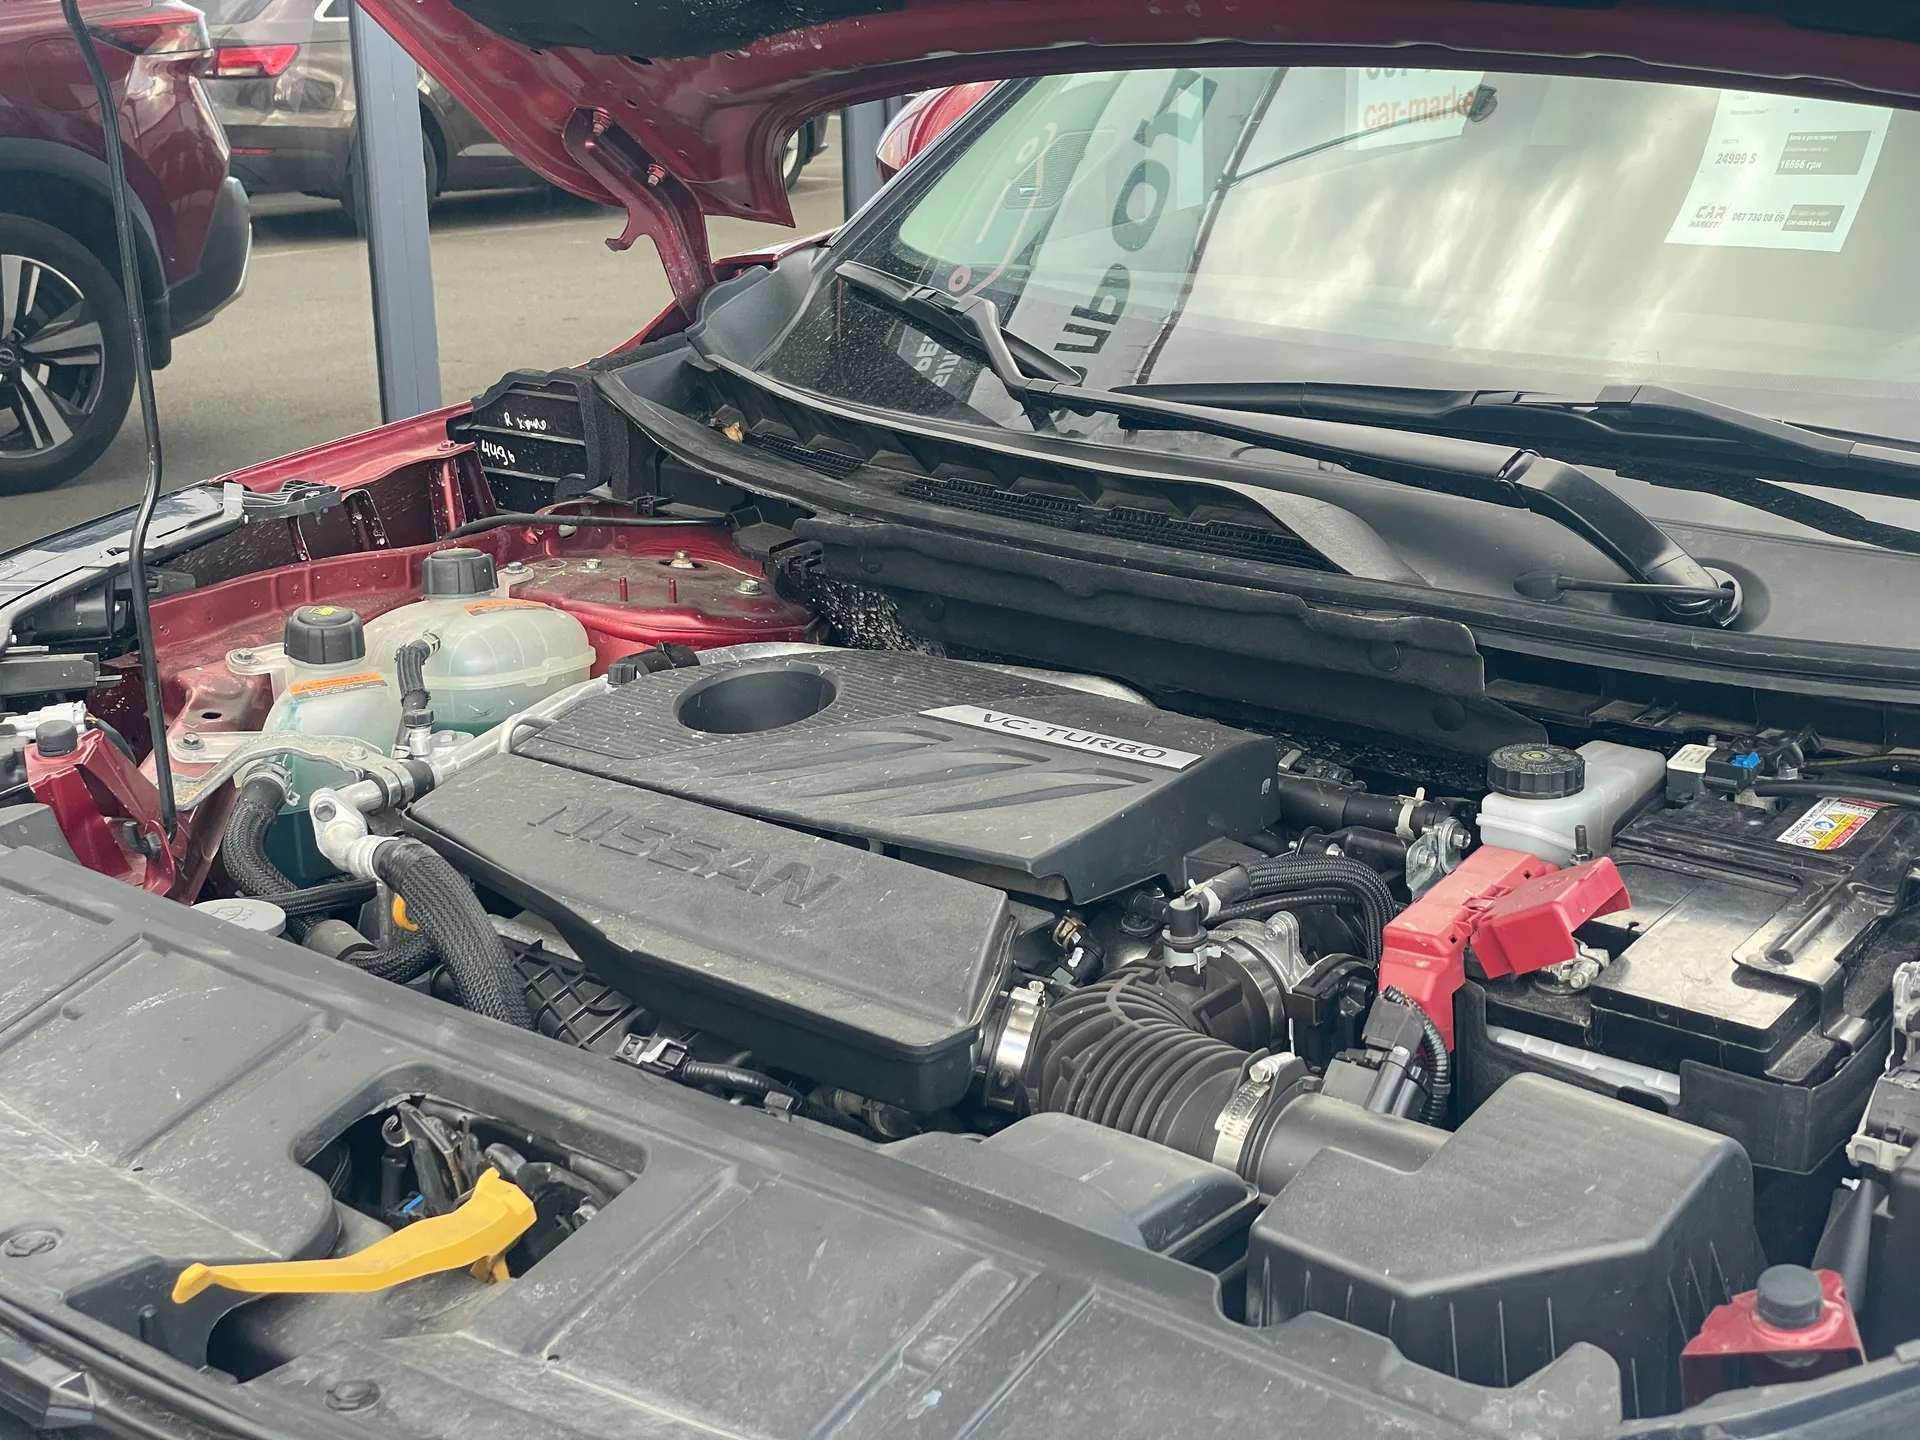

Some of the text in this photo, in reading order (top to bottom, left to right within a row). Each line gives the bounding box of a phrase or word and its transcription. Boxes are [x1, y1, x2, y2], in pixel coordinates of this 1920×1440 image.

[1715, 153, 1747, 165] 24999
[1780, 159, 1822, 171] 16666 грн
[1696, 205, 1727, 219] CAR
[1732, 213, 1747, 221] 067
[1747, 213, 1762, 222] 730
[1763, 213, 1774, 222] 08
[526, 800, 848, 911] NISSAN
